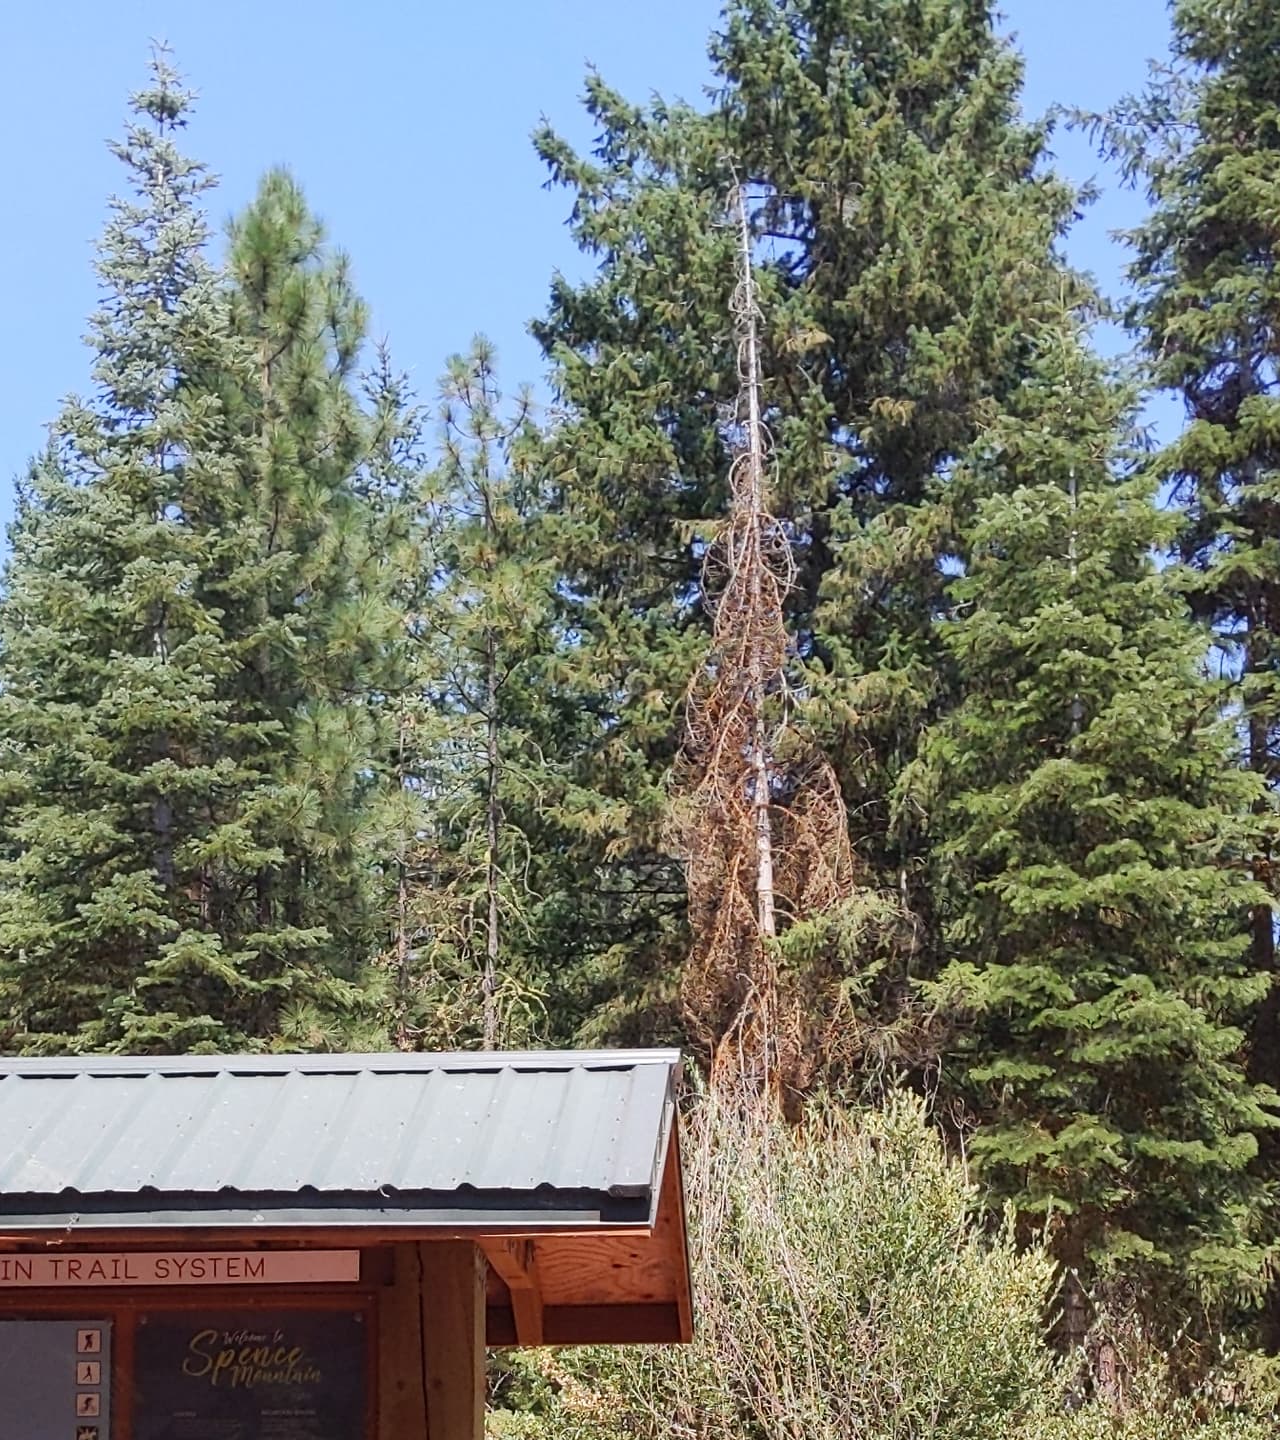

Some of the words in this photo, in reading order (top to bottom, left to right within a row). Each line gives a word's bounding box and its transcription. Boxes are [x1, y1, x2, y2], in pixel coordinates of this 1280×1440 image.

[48, 1258, 139, 1281] TRAIL
[154, 1257, 266, 1280] SYSTEM
[182, 1329, 304, 1386] Spence
[231, 1363, 322, 1388] Mountain
